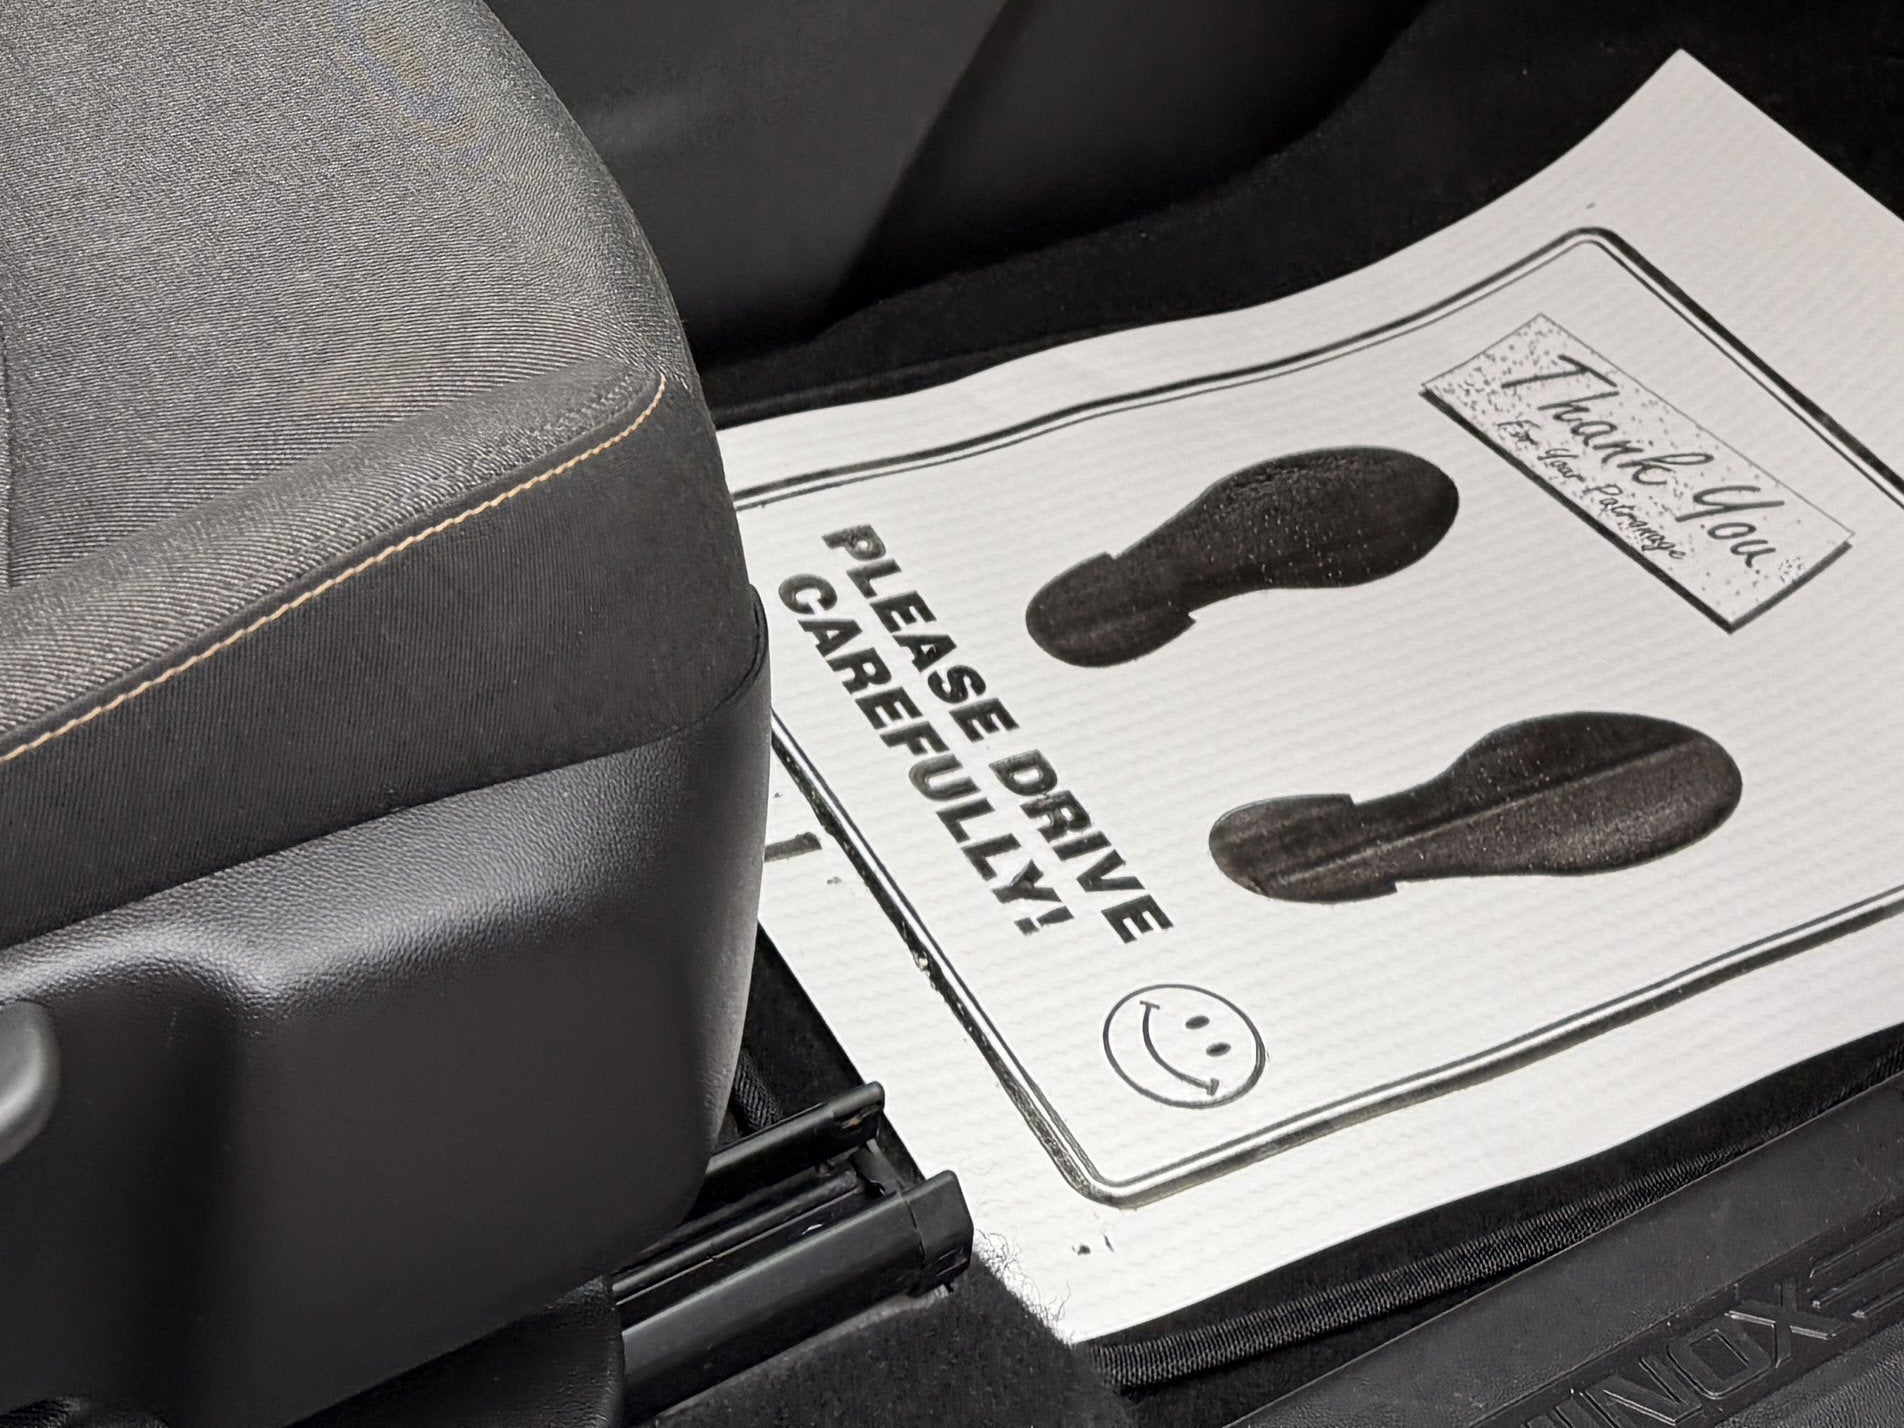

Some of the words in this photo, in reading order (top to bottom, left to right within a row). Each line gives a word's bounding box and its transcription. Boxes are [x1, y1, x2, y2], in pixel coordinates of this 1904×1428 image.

[1500, 353, 1715, 487] Thank
[1537, 446, 1586, 483] Your
[1584, 482, 1688, 562] Patronage
[777, 572, 1076, 936] CAREFULLY!
[820, 523, 1020, 743] PLEASE
[988, 748, 1175, 945] DRIVE
